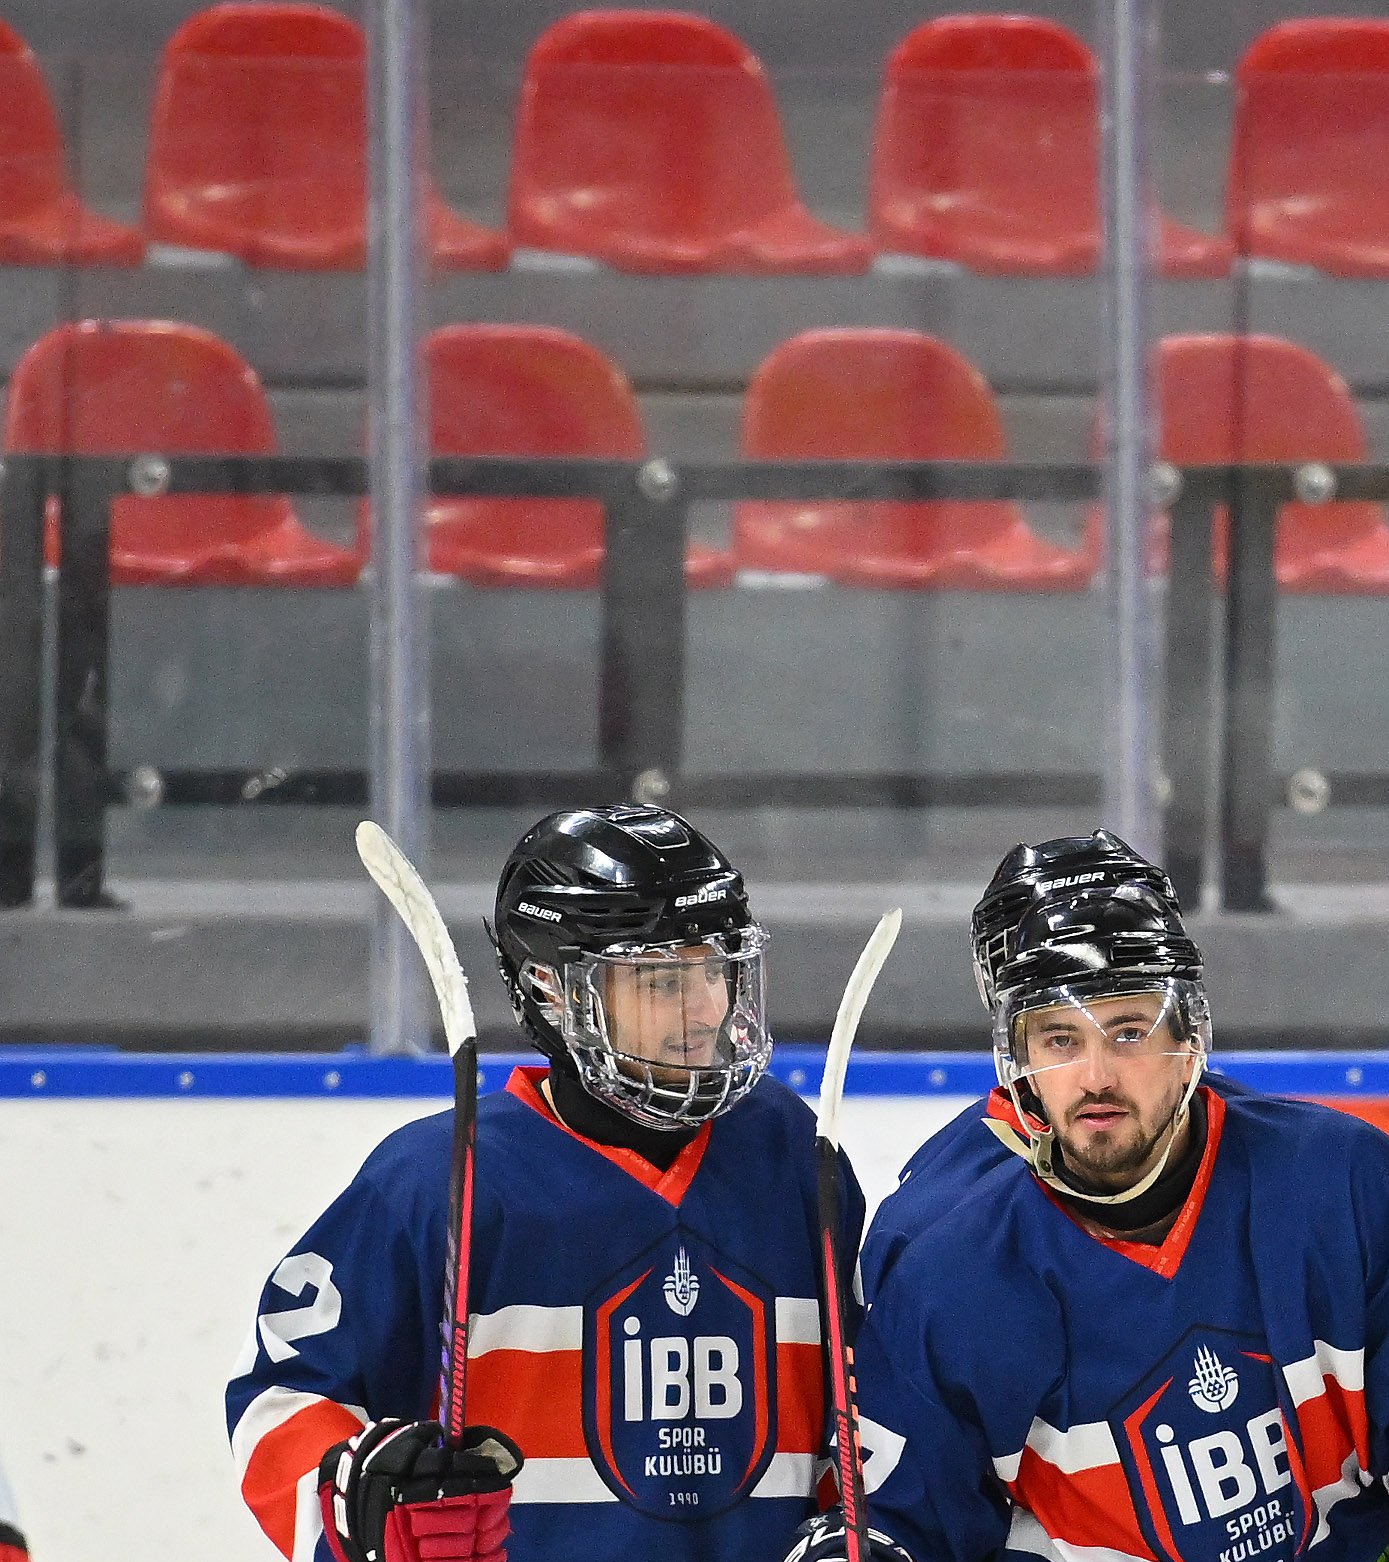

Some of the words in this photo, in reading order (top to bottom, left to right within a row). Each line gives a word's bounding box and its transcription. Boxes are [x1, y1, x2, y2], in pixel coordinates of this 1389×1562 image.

[1039, 871, 1106, 892] BAUER
[675, 888, 727, 907] BAUER
[518, 902, 562, 923] BAUER
[658, 1427, 706, 1449] SPOR
[644, 1448, 722, 1477] KULÜBÜ
[669, 1492, 699, 1506] 1990
[1225, 1499, 1282, 1541] SPOR
